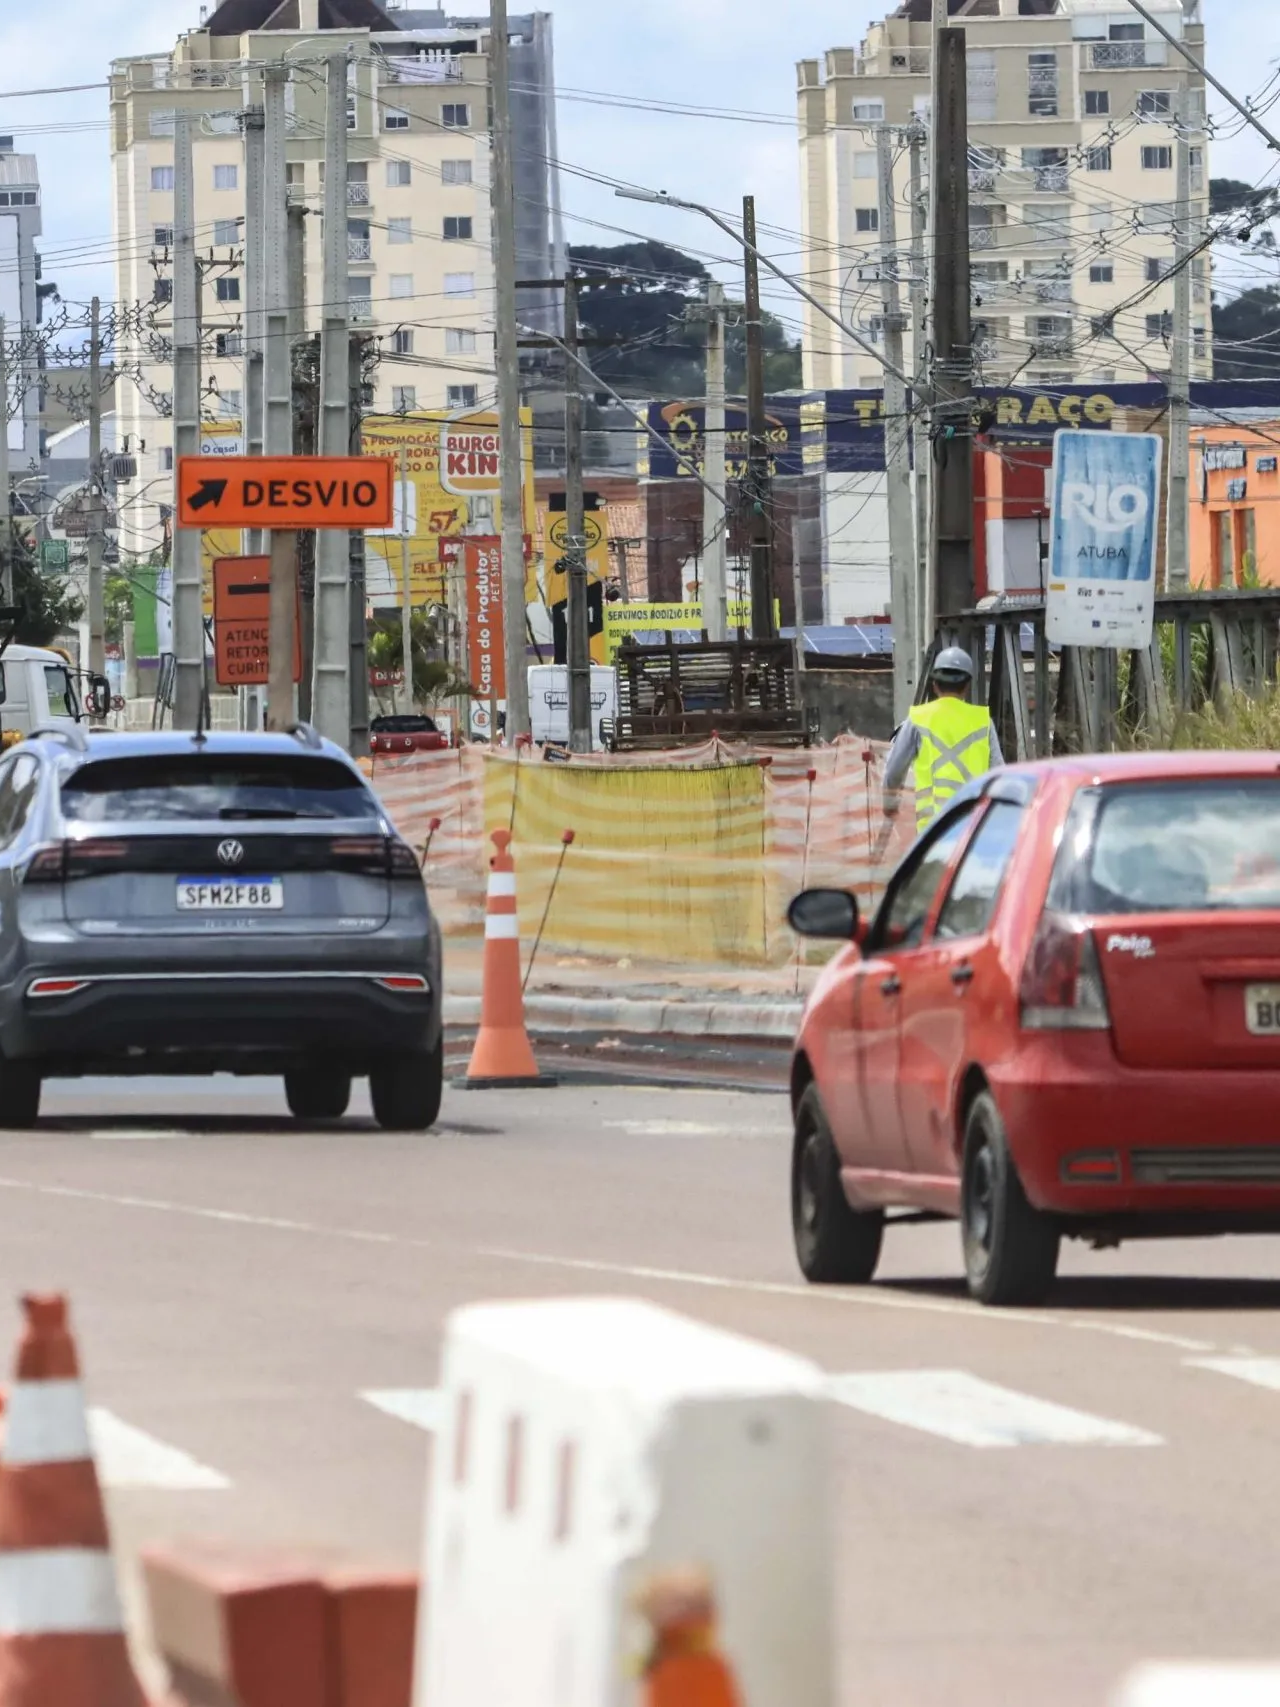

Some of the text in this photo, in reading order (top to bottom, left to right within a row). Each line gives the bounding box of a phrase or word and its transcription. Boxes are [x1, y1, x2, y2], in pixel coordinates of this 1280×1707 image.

[202, 443, 238, 454] O casal
[447, 435, 500, 452] BURG
[447, 453, 499, 475] KIN
[242, 480, 377, 508] DESVIO
[1061, 481, 1148, 532] RIO
[1077, 546, 1128, 559] ATUBA
[490, 548, 501, 602] PET SHOP
[476, 549, 491, 694] Casa do Produtor
[608, 609, 648, 621] SERVIMOS
[684, 608, 690, 618] E
[227, 645, 269, 658] RETOR
